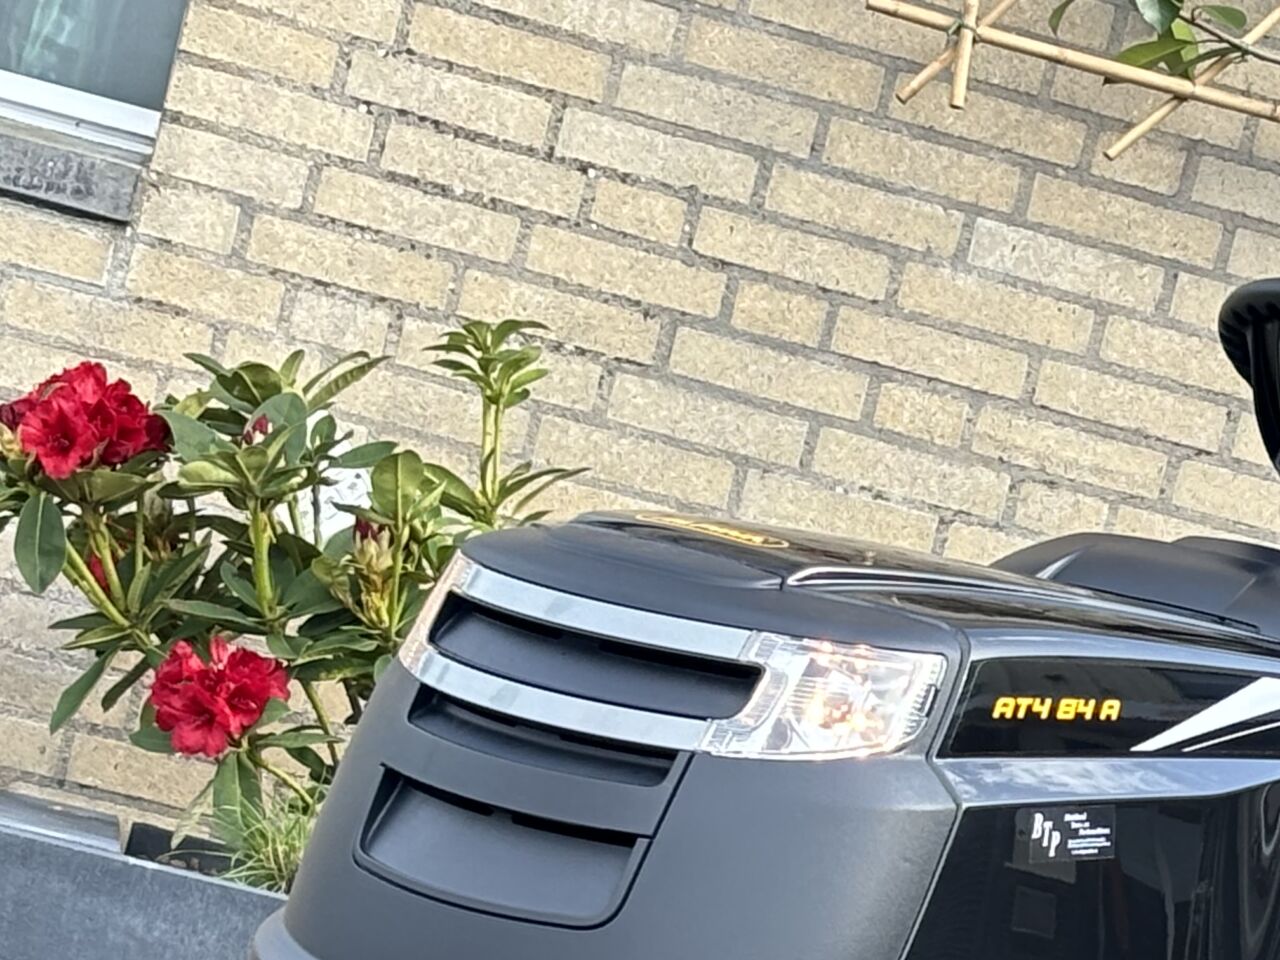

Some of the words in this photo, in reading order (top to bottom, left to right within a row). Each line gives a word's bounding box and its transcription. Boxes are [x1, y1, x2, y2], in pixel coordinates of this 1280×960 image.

[992, 697, 1052, 719] AT4
[1056, 698, 1096, 720] 84
[1099, 699, 1121, 721] A
